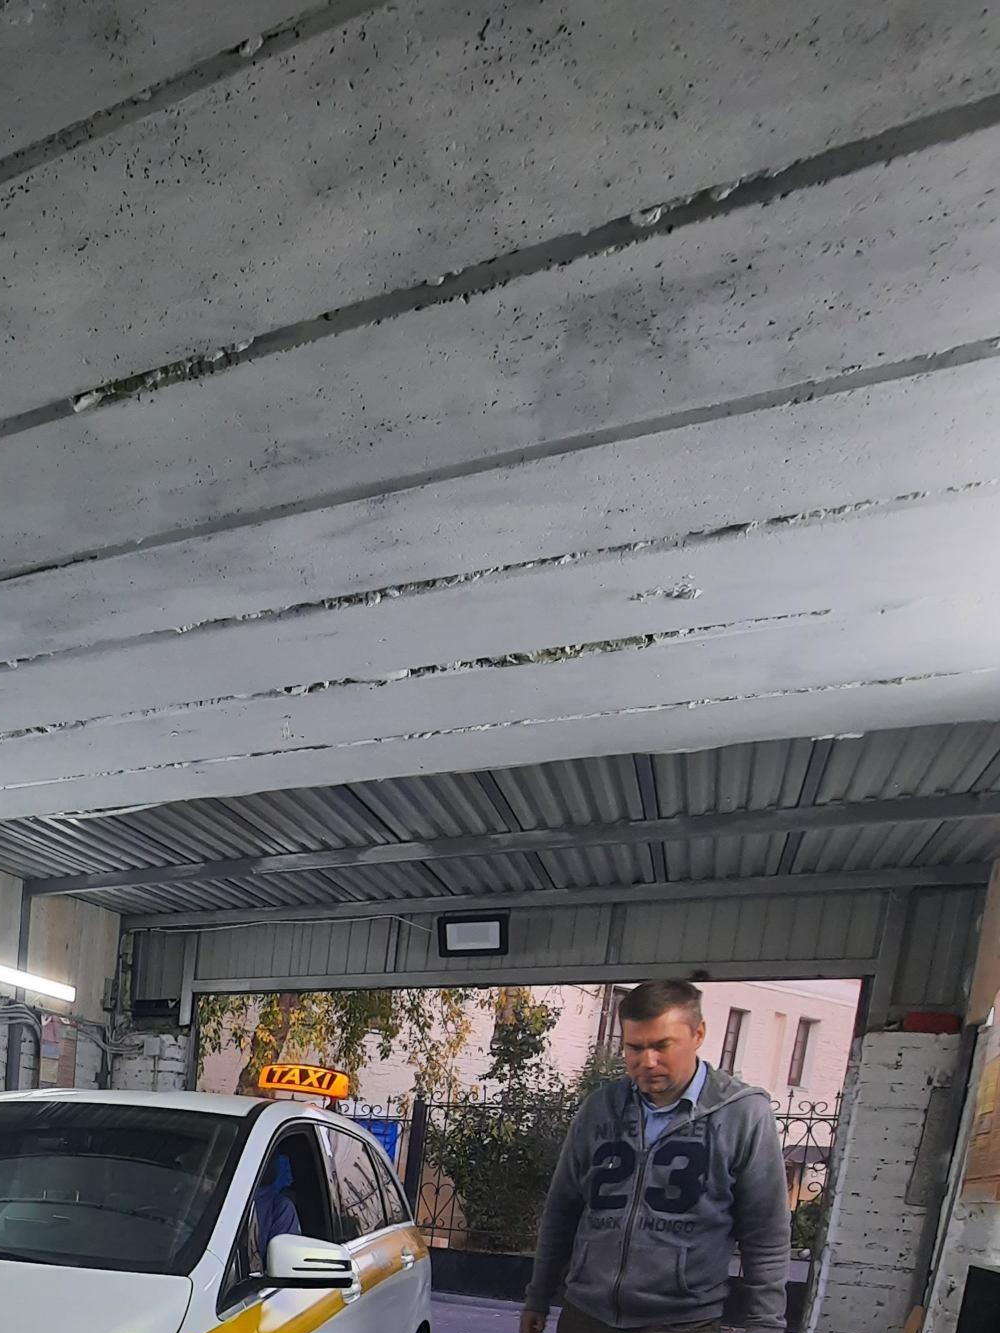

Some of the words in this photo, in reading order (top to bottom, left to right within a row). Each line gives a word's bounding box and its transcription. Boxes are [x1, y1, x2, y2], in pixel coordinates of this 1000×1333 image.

[272, 1067, 332, 1089] TAXI
[590, 1140, 708, 1213] 23
[638, 1216, 697, 1234] INDIGO
